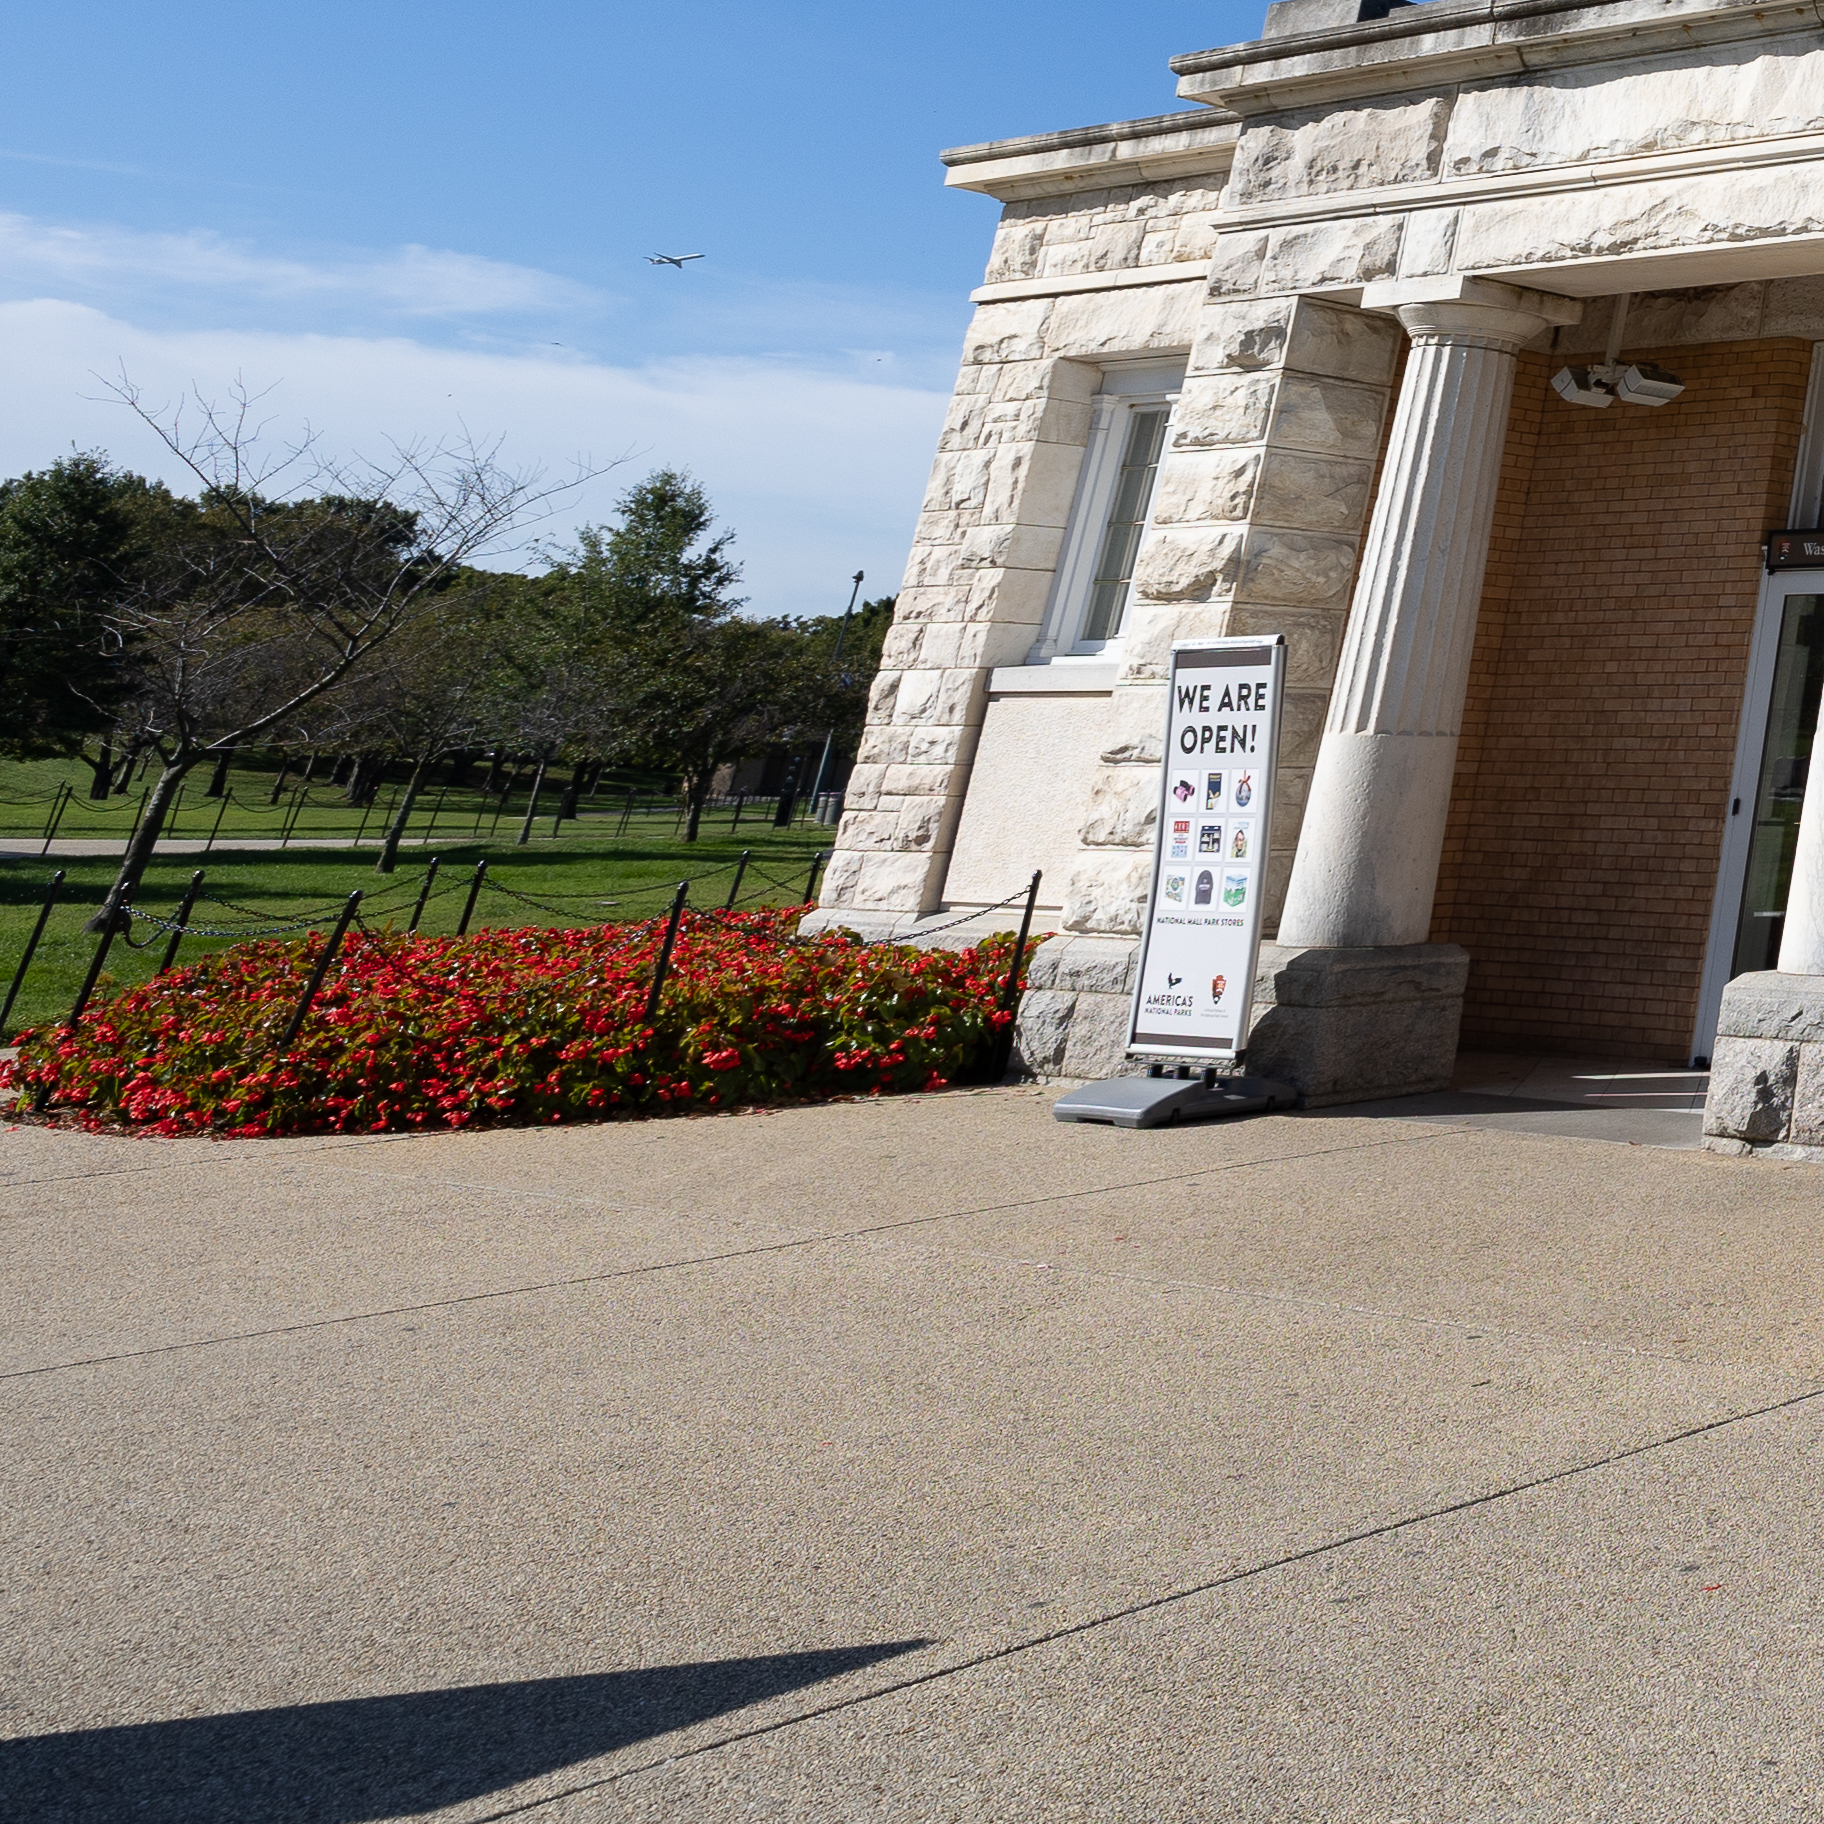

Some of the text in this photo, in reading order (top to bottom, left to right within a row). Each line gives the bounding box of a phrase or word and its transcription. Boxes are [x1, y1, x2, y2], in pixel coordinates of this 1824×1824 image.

[1177, 682, 1268, 713] WE ARE
[1180, 724, 1257, 754] OPEN!
[1156, 916, 1244, 927] NATIONAL MALL PARK STORES
[1146, 994, 1194, 1007] AMERICA'S
[1144, 1007, 1173, 1015] NATIONAL
[1174, 1008, 1192, 1016] PARKS
